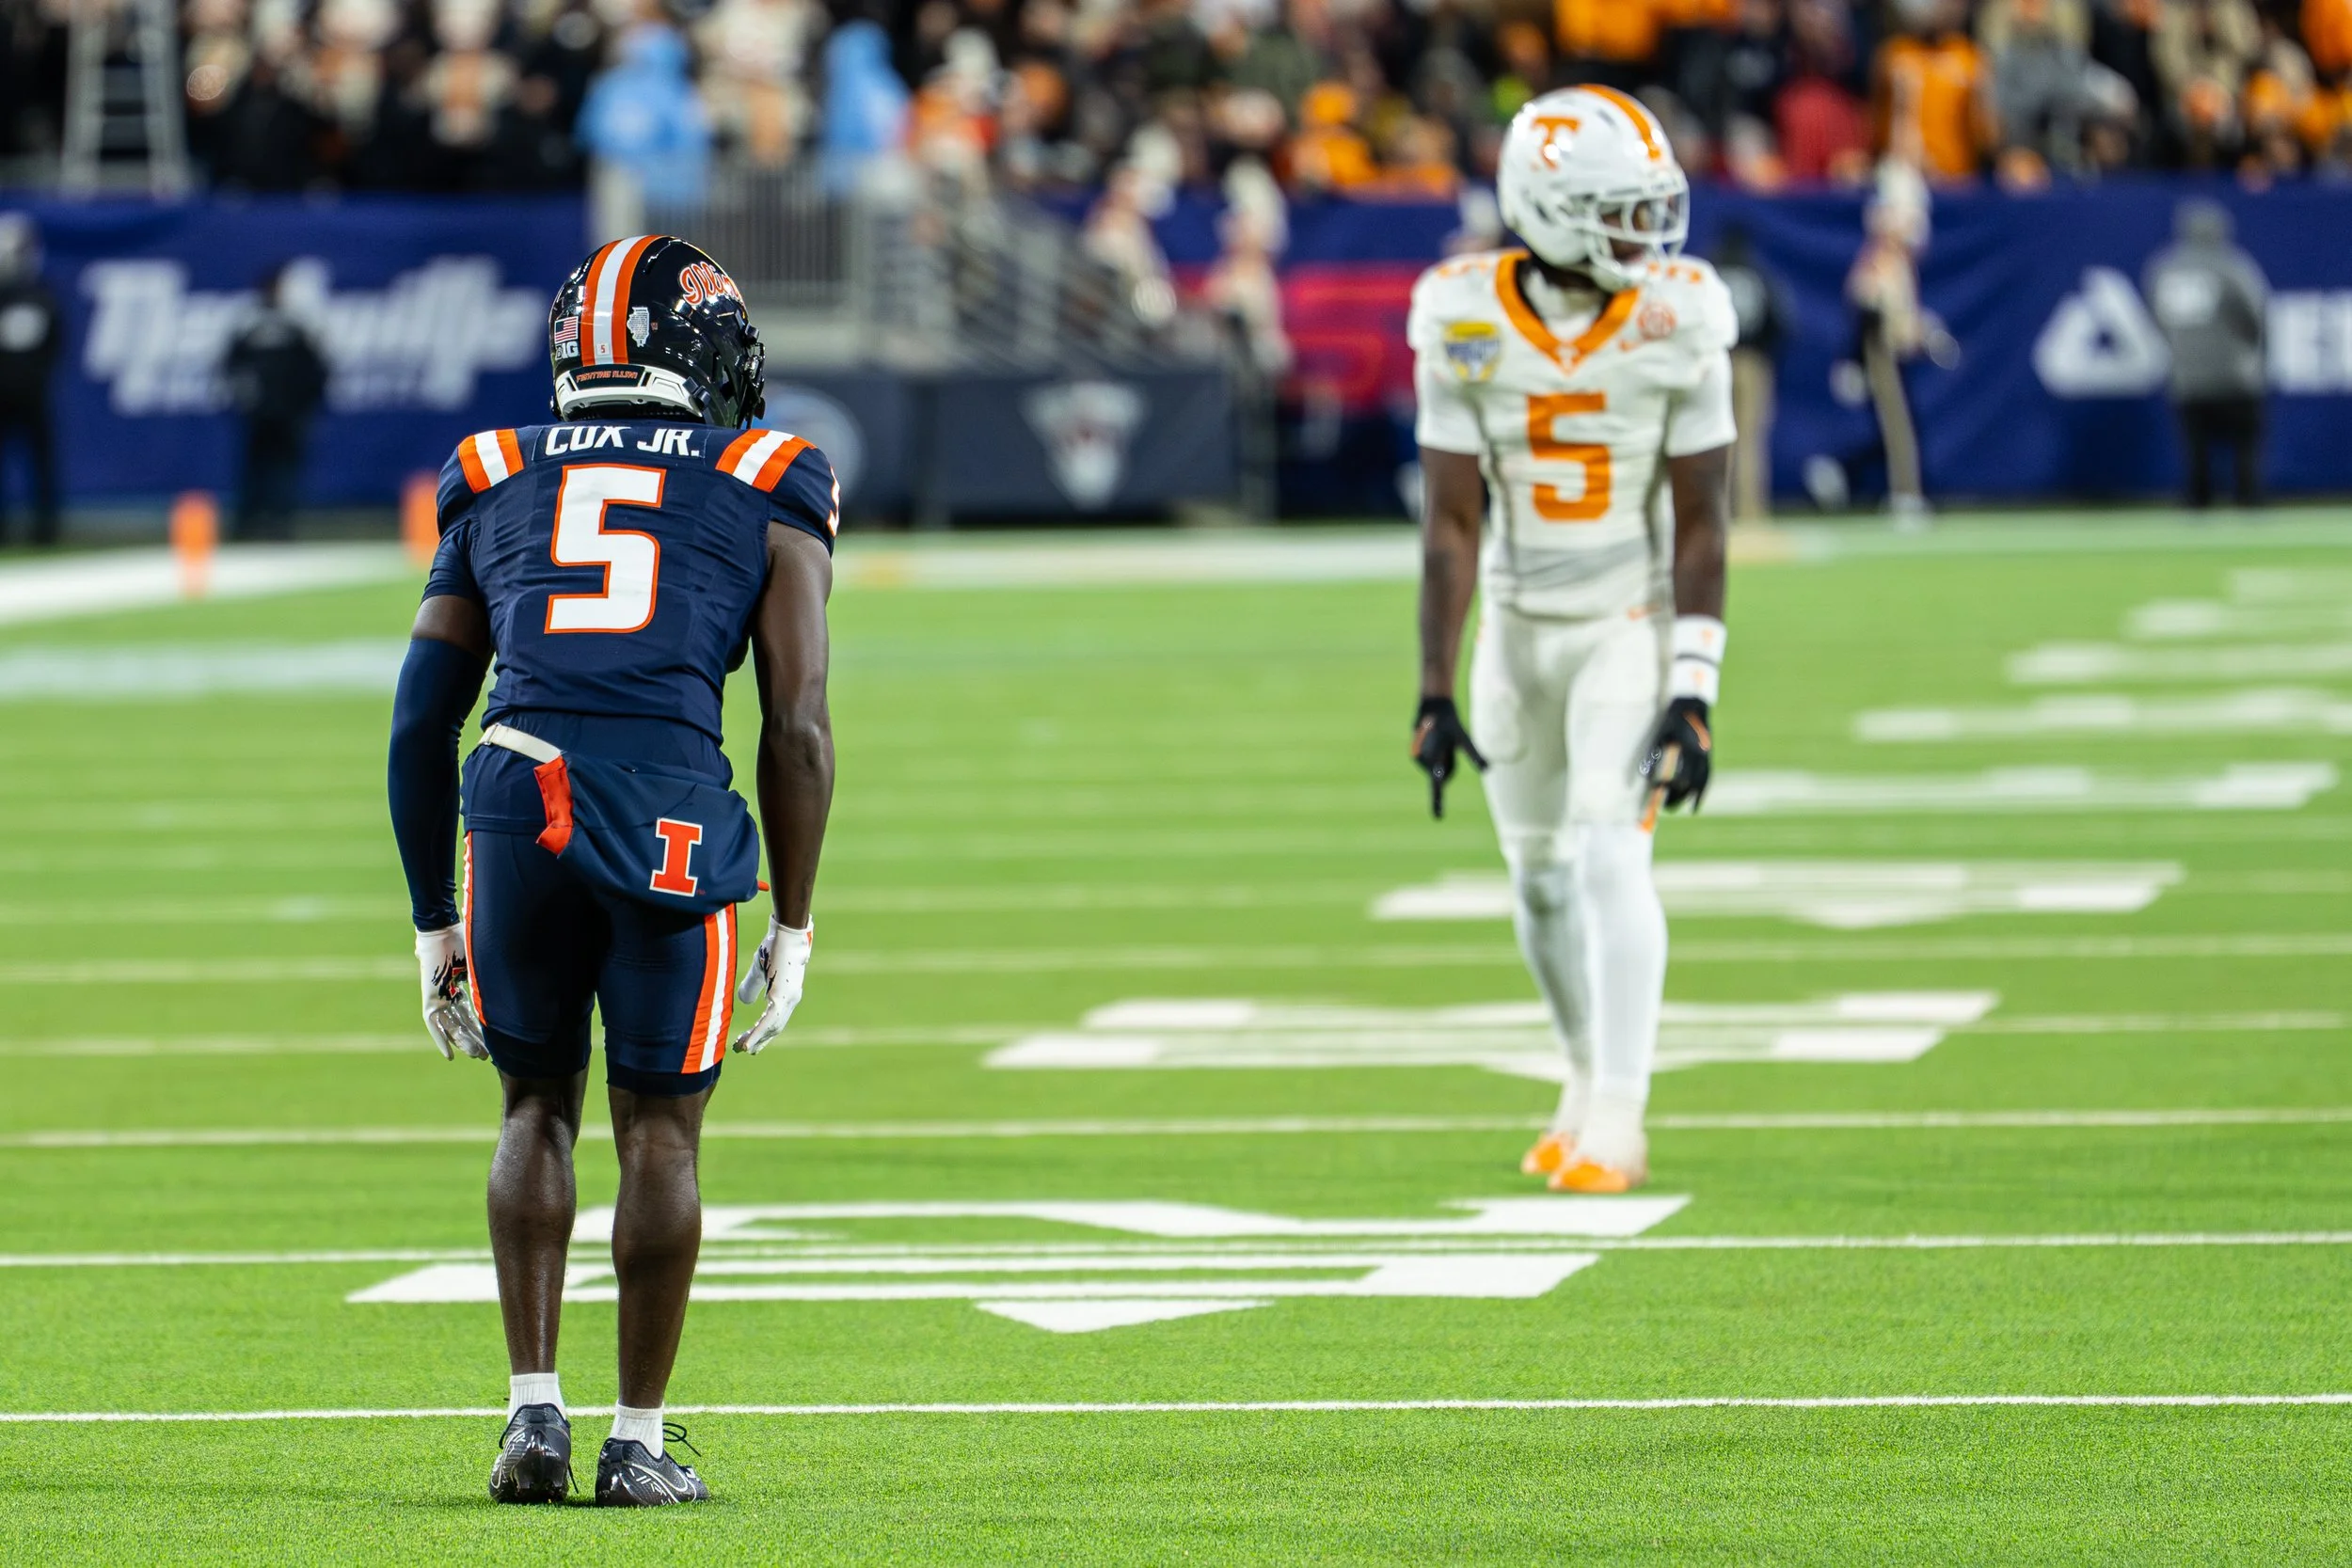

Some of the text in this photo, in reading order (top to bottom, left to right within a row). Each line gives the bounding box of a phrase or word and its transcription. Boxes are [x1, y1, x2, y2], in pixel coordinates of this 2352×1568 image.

[1531, 115, 1581, 171] T
[576, 371, 638, 383] FIGHTING ILLINI
[545, 425, 701, 457] COX JR.
[1525, 389, 1613, 524] 5
[544, 463, 667, 634] 5
[649, 816, 703, 897] I
